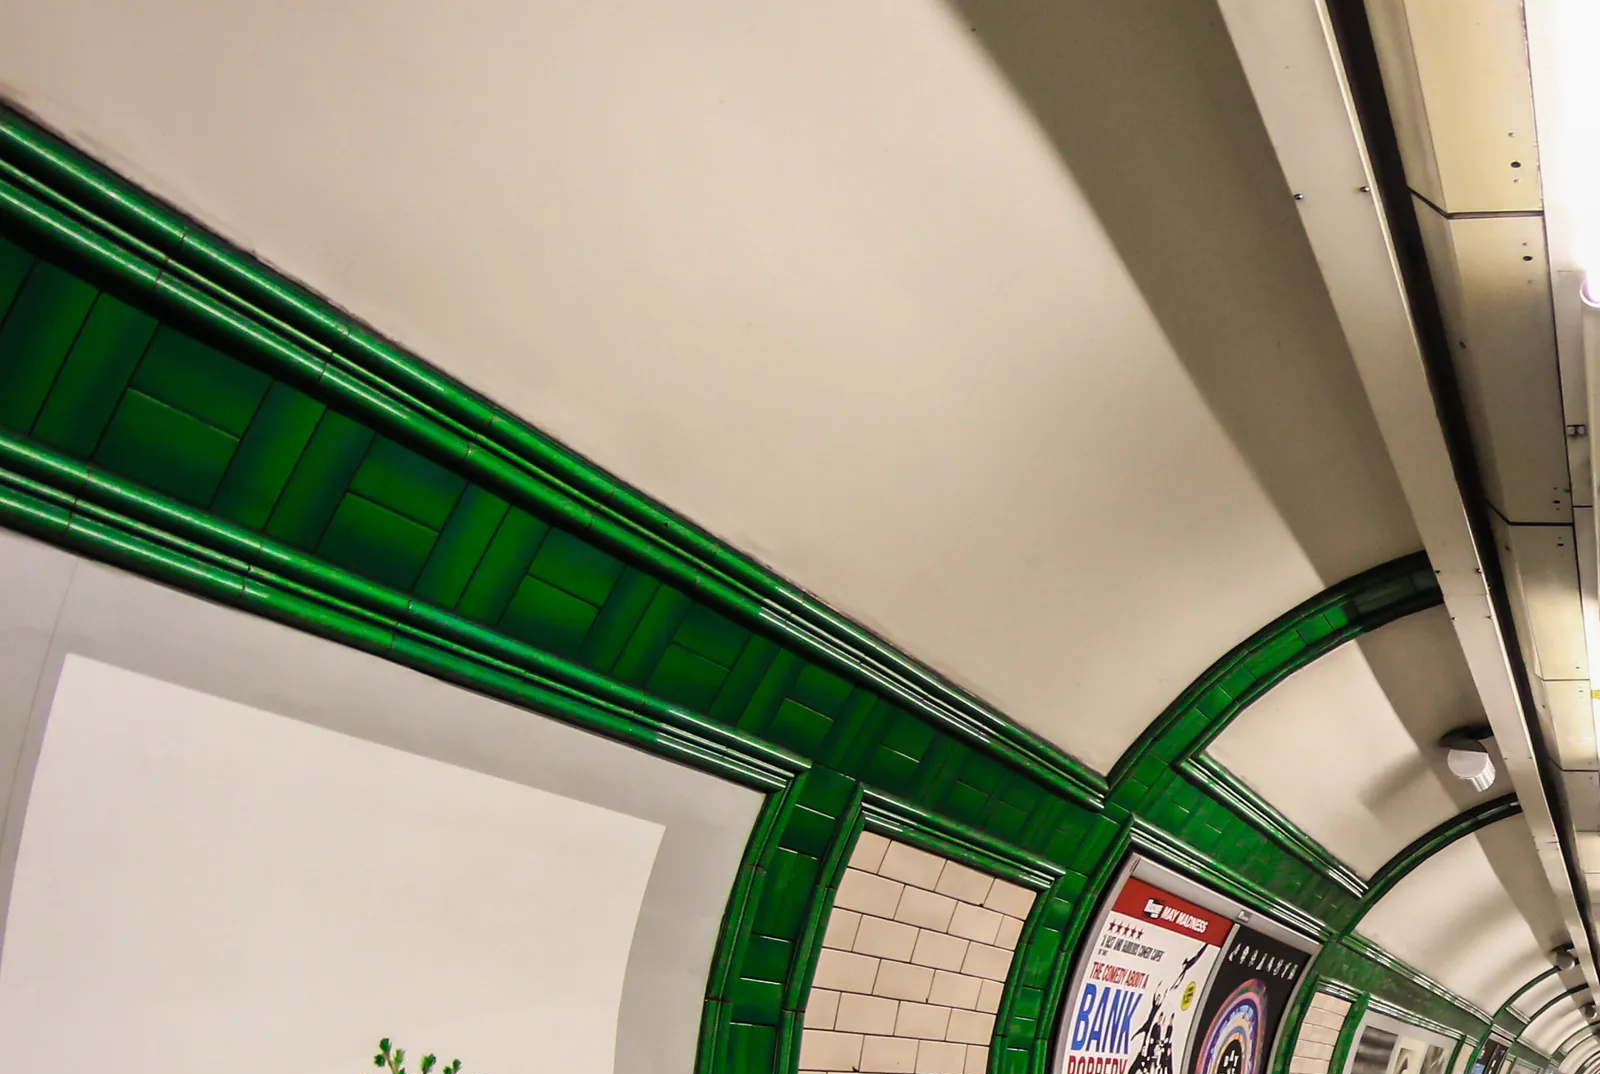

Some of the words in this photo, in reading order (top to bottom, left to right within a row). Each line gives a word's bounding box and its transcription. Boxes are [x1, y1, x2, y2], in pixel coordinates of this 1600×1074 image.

[1160, 905, 1178, 923] MAY
[1177, 911, 1209, 934] MADNESS
[1090, 961, 1108, 980] THE
[1103, 964, 1129, 985] COMEDY
[1125, 968, 1146, 989] ABOUT
[1142, 974, 1150, 990] A
[1071, 983, 1143, 1055] BANK
